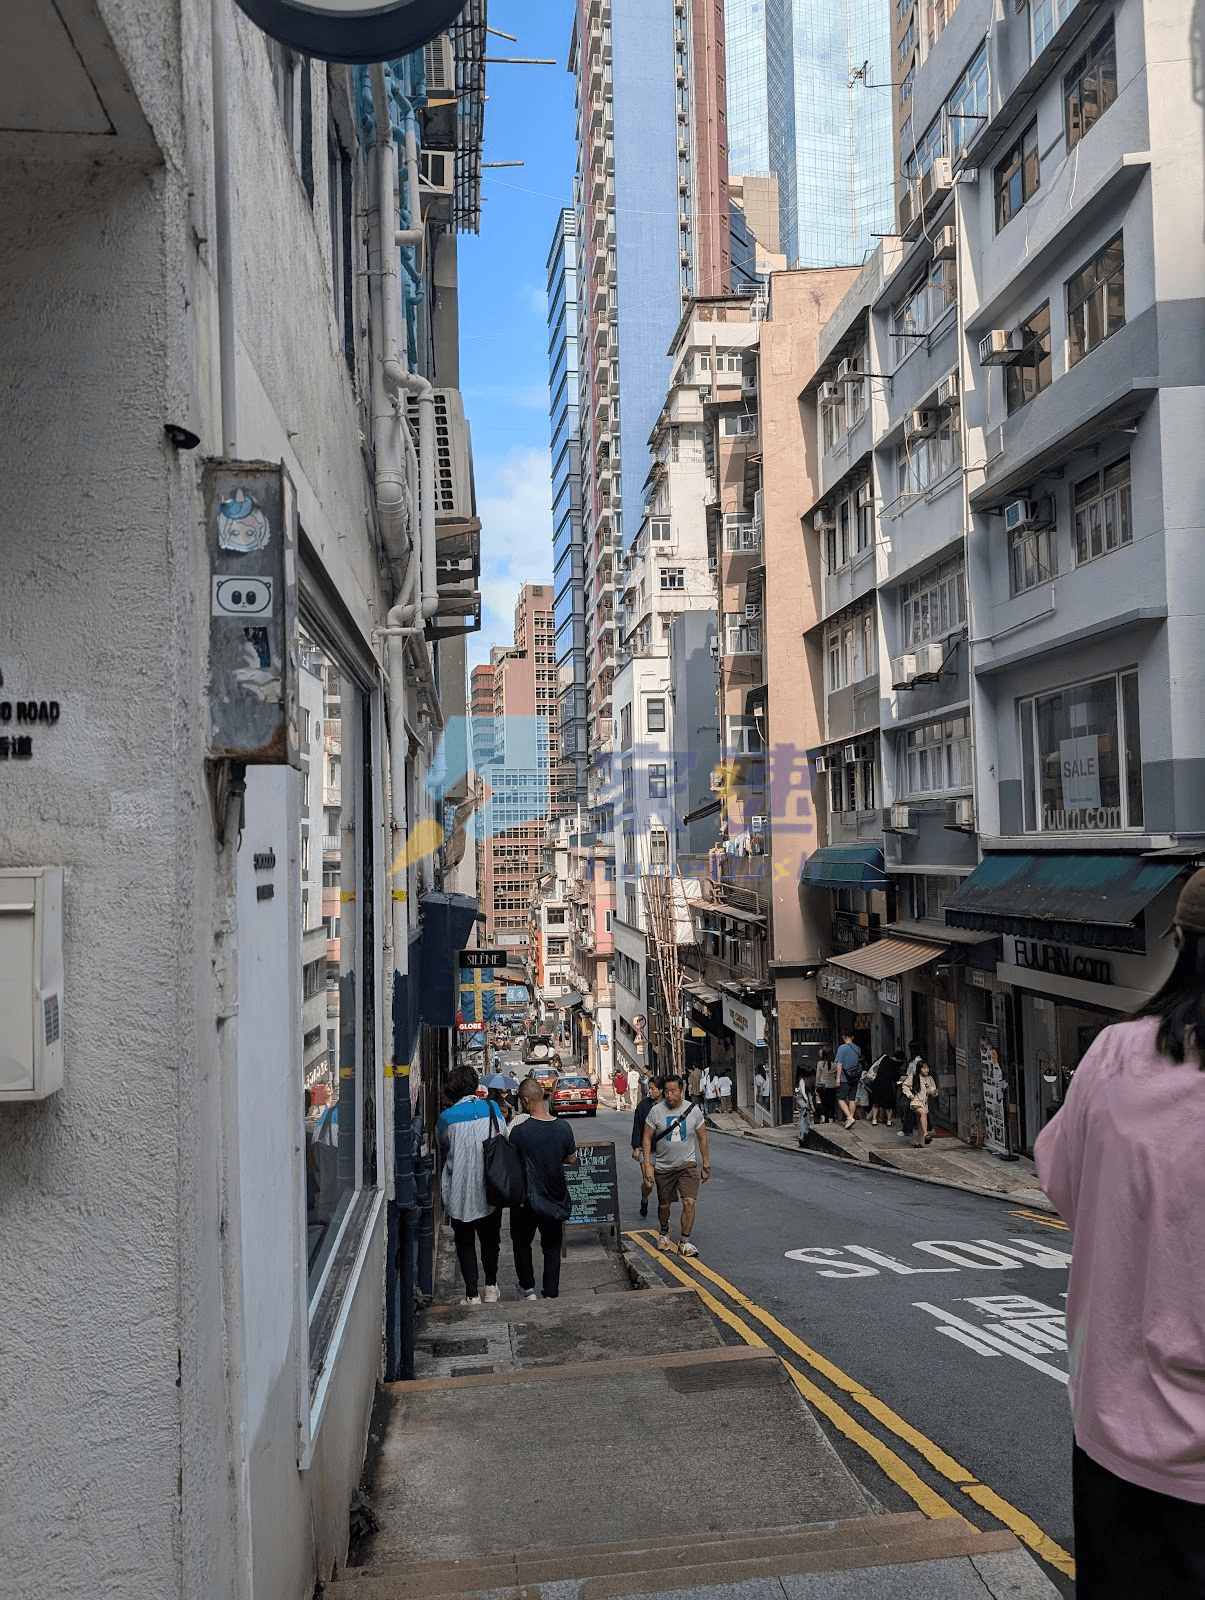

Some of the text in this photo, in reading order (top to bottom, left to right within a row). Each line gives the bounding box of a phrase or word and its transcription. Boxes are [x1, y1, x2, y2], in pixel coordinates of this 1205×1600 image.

[16, 701, 60, 722] ROAD
[1063, 757, 1096, 779] SALE
[1042, 803, 1120, 831] fuurn.com
[466, 952, 501, 966] SILÈNE
[459, 1022, 482, 1030] GLOBE
[784, 1238, 1072, 1278] SLOW
